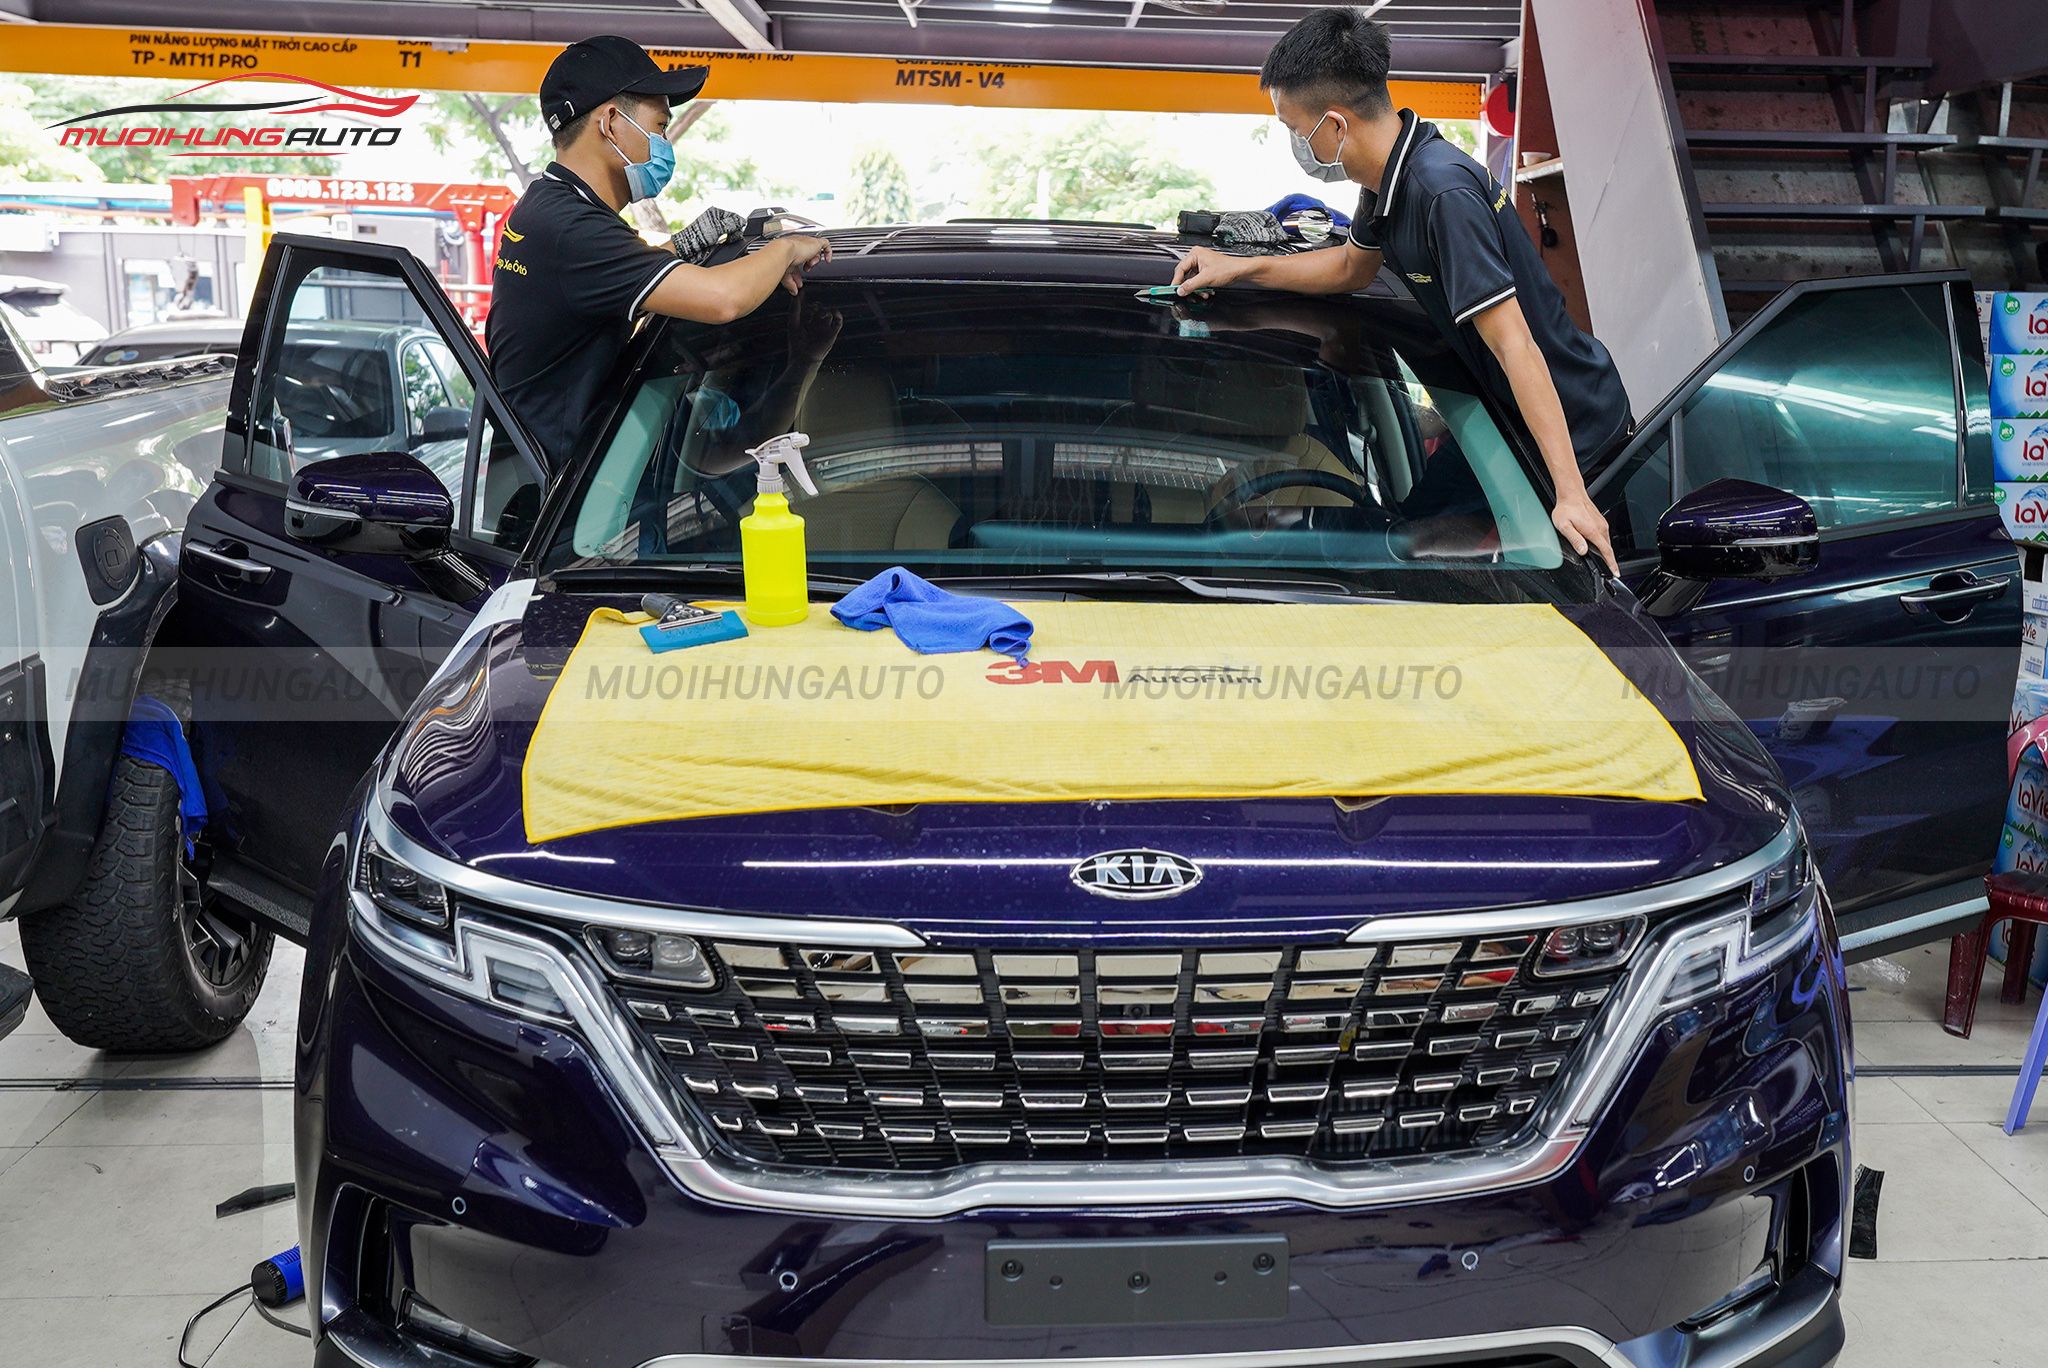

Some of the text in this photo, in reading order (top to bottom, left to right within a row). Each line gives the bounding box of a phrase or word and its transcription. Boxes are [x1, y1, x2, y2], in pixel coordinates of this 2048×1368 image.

[129, 34, 151, 44] PIN
[193, 36, 238, 49] LƯỢNG
[303, 41, 330, 52] CAO
[332, 38, 358, 53] CẤP
[131, 50, 155, 64] TP
[169, 52, 214, 67] MT11
[218, 55, 258, 69] PRO
[399, 50, 422, 67] T1
[895, 69, 962, 87] MTSM
[978, 72, 1005, 88] V4
[985, 660, 1120, 685] 3M
[1094, 855, 1184, 885] KIA
